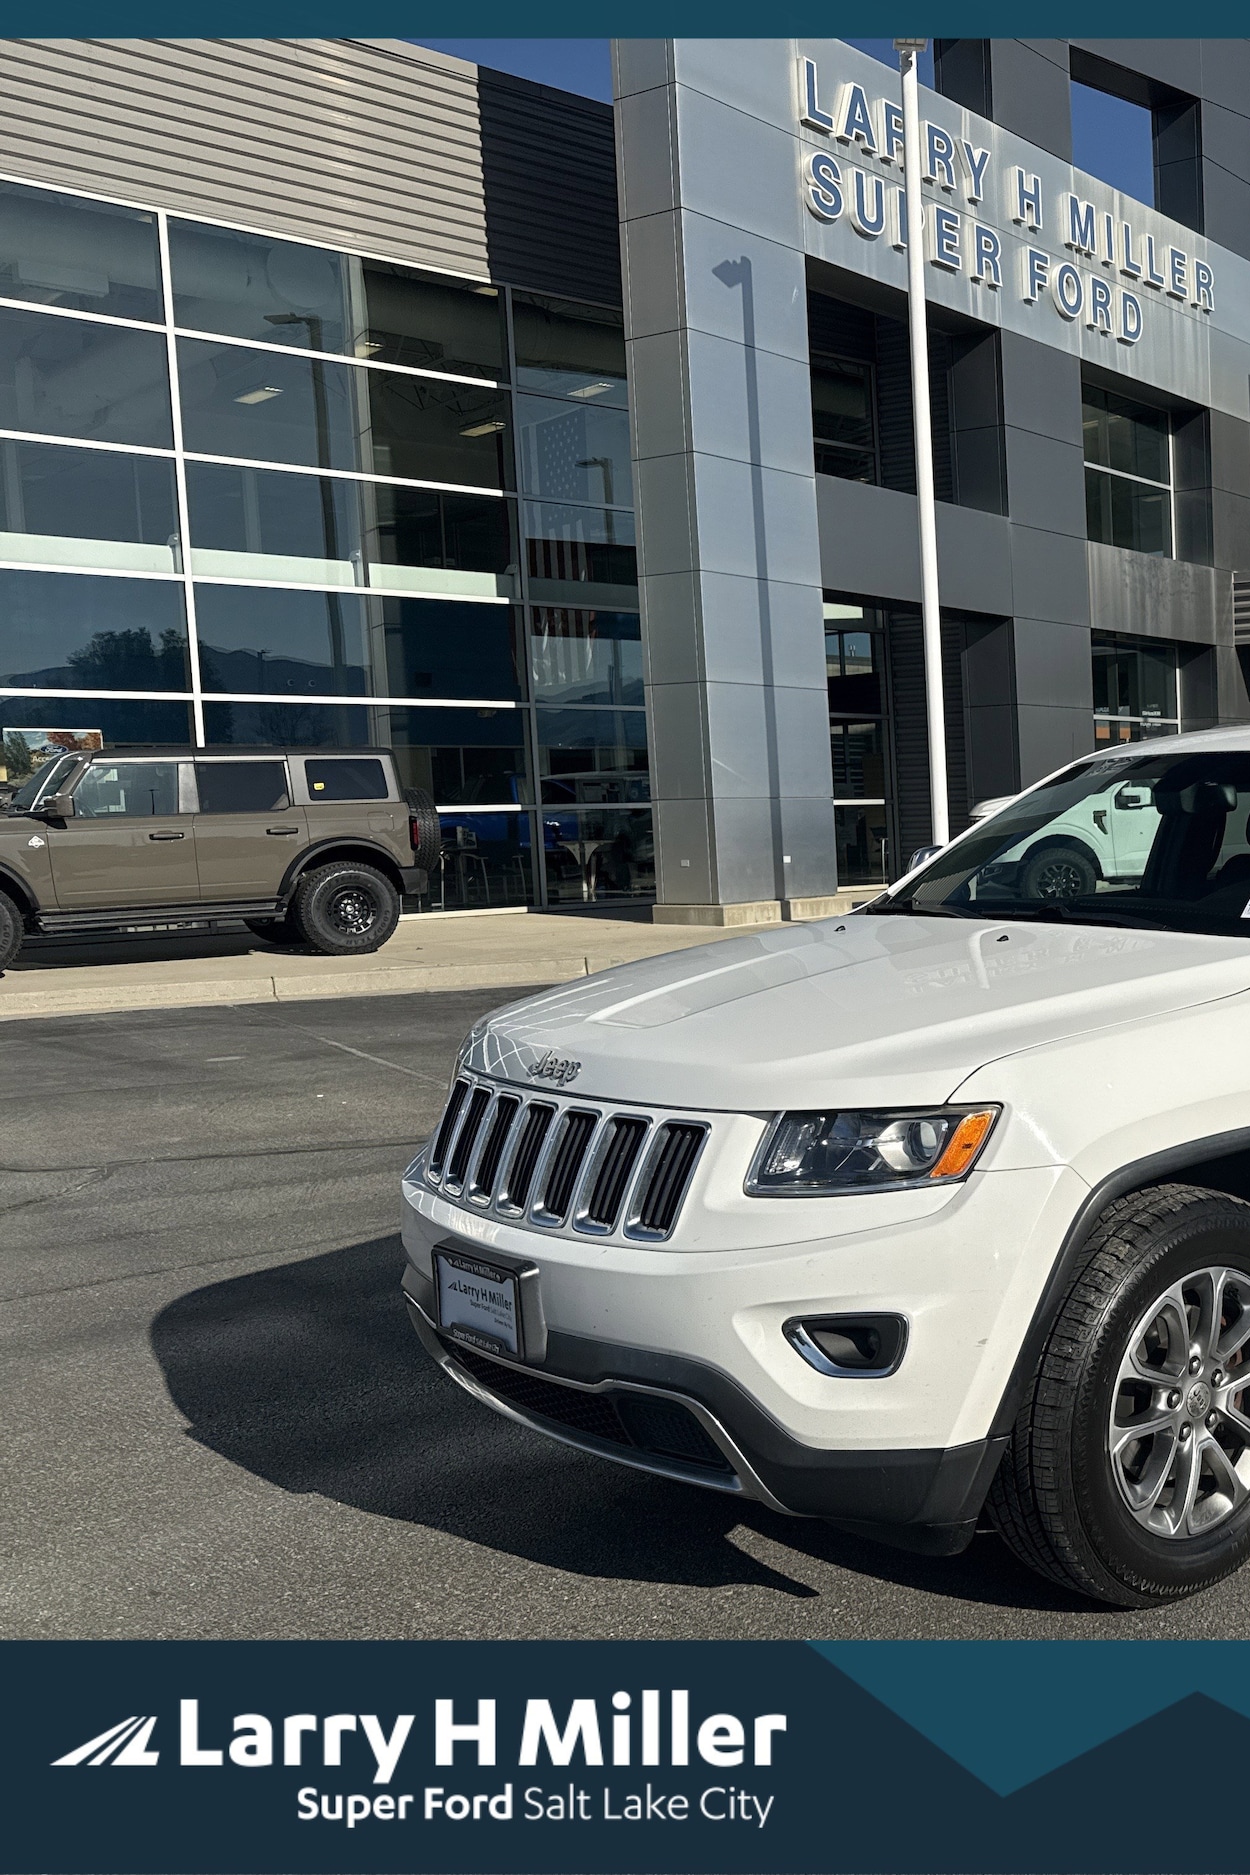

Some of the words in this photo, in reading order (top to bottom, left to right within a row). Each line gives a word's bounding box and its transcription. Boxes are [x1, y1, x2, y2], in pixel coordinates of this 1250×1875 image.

[1012, 165, 1043, 230] H
[1064, 191, 1215, 313] MILLER
[1021, 245, 1143, 344] FORD
[526, 1050, 582, 1087] Jeep
[458, 1280, 480, 1302] Larry
[481, 1287, 488, 1302] H
[488, 1290, 513, 1312] Miller
